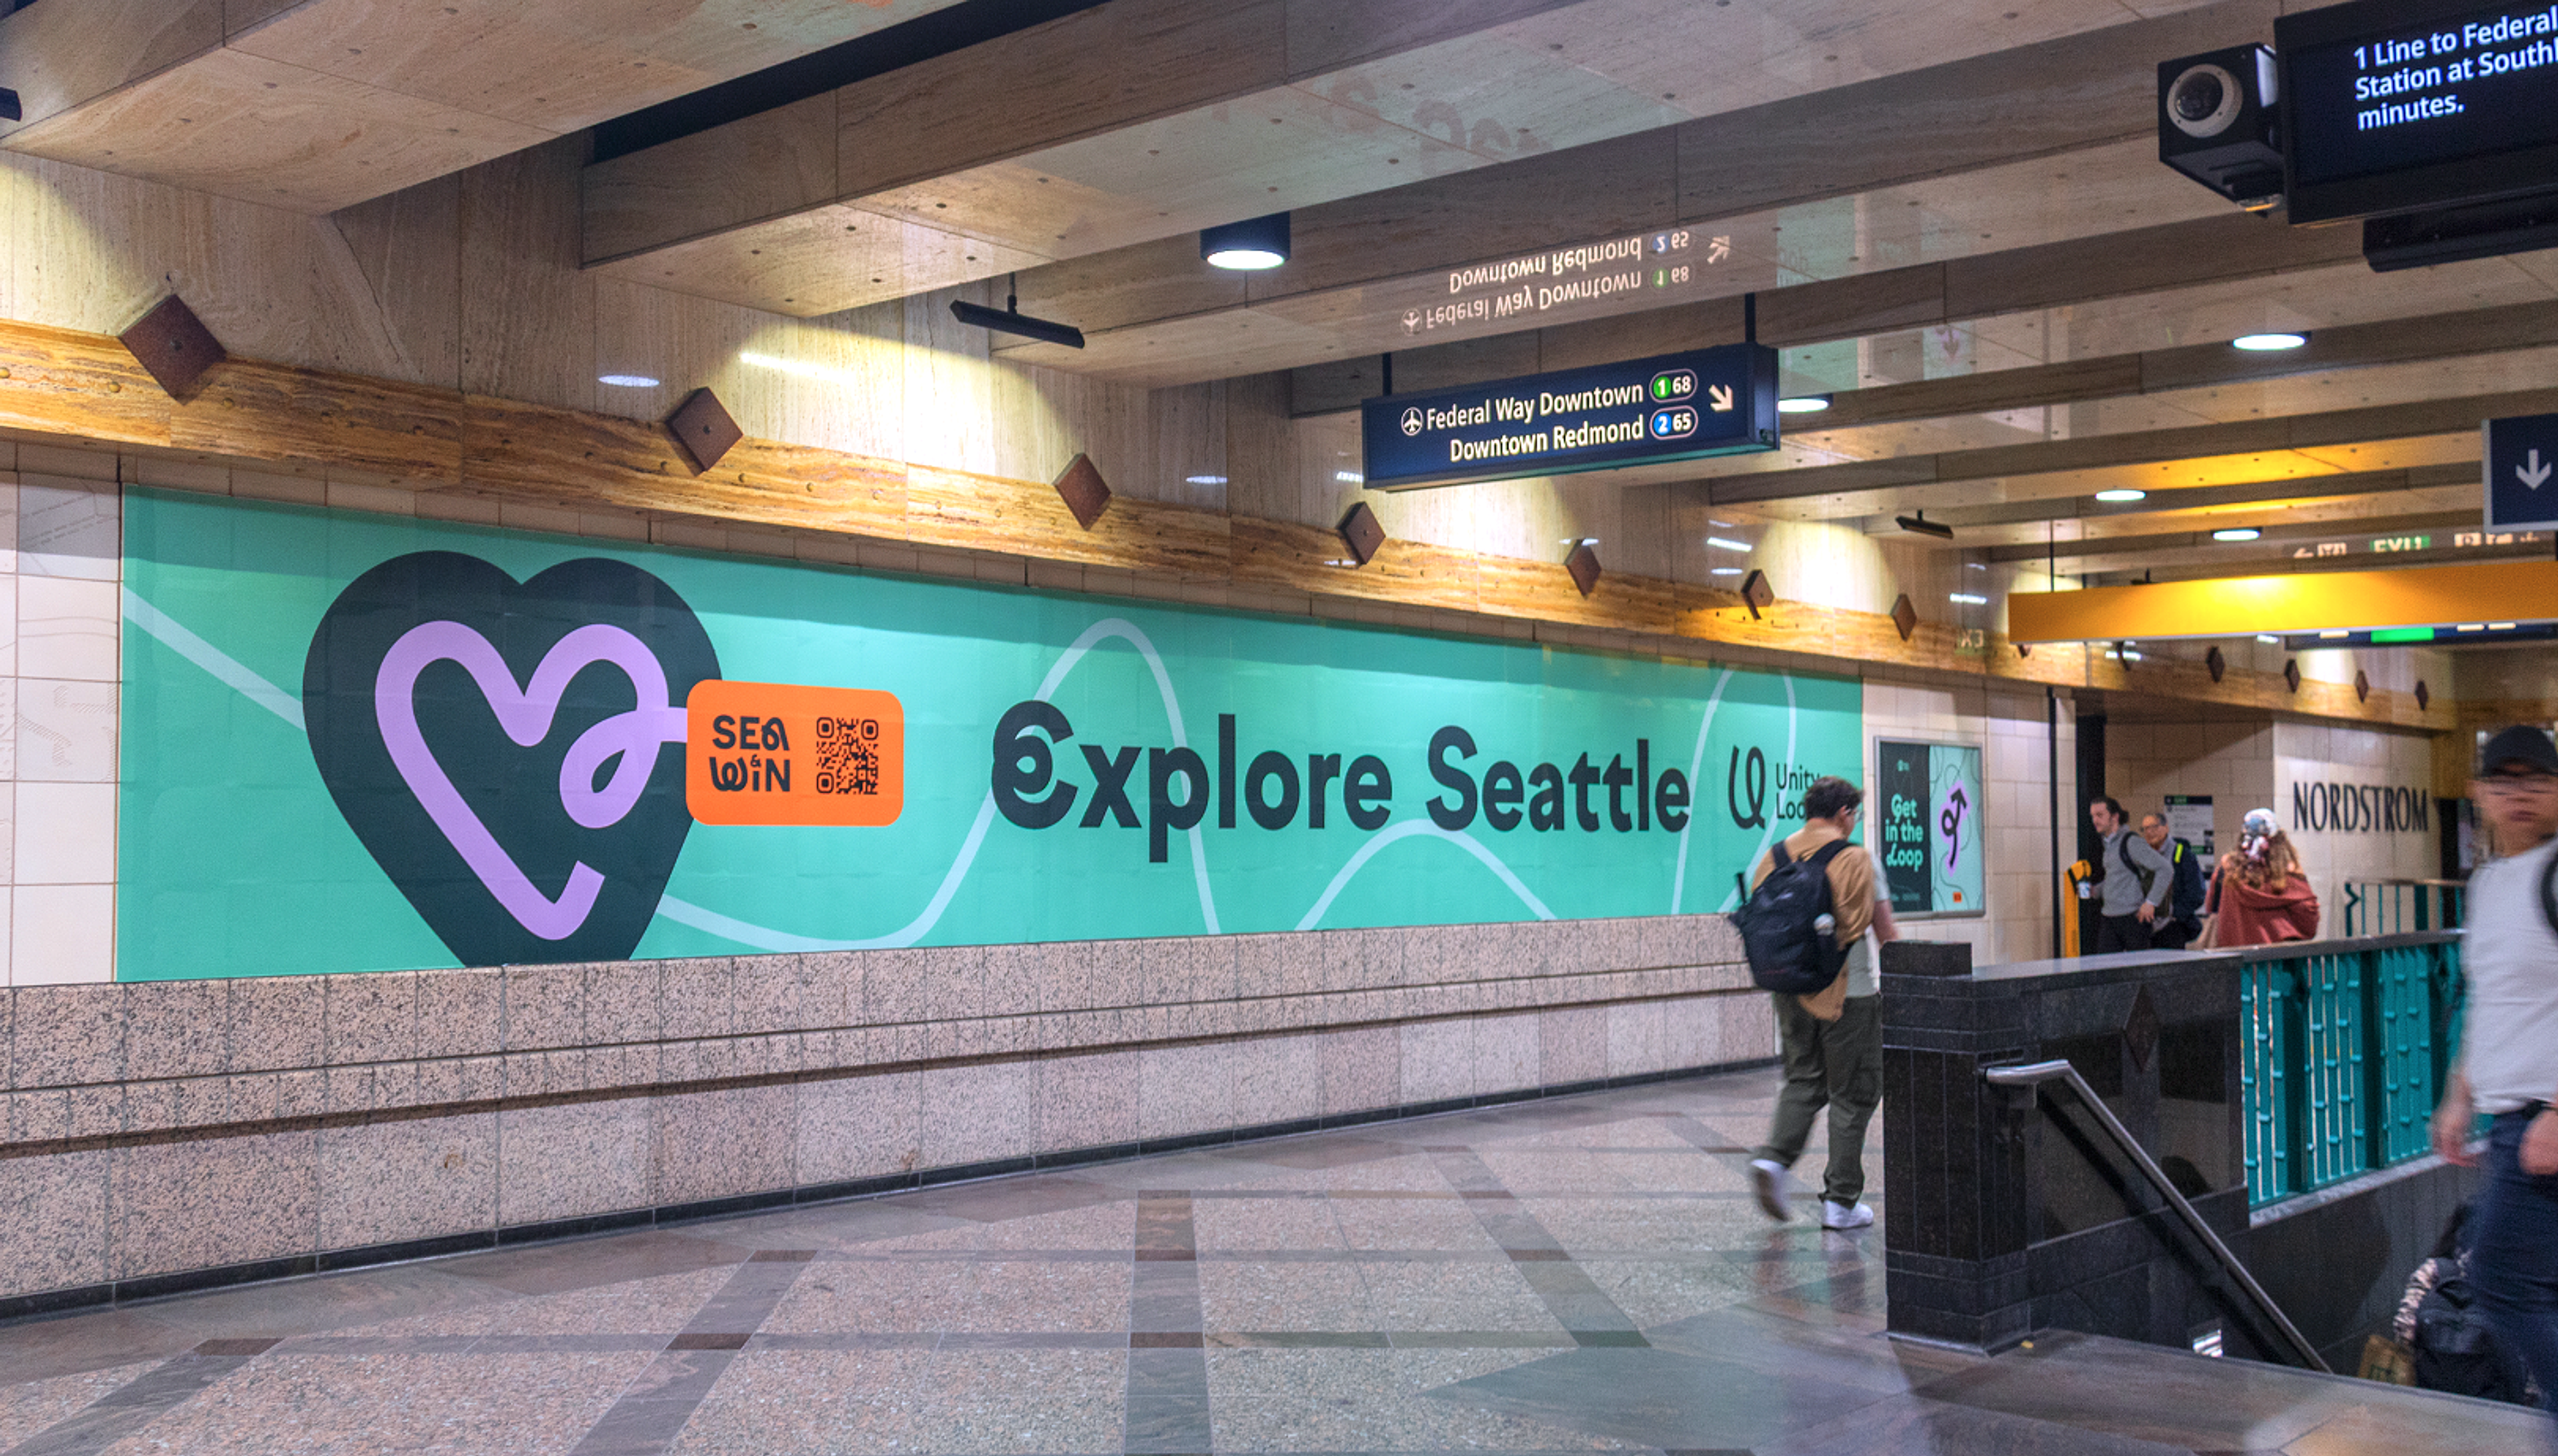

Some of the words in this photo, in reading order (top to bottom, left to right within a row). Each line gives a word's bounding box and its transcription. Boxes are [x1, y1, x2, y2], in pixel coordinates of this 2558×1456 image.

[2353, 46, 2367, 70] 1
[2373, 39, 2426, 67] Line
[2429, 32, 2459, 55] to
[2462, 5, 2558, 49] Federal
[2355, 67, 2442, 101] Station
[2447, 57, 2474, 83] at
[2357, 94, 2465, 131] minutes.
[1427, 399, 1491, 430] Federal
[1495, 397, 1535, 424] Way
[1539, 384, 1643, 416] Downtown
[1658, 380, 1665, 395] 1
[1673, 376, 1691, 394] 68
[1450, 432, 1548, 462] Downtown
[1553, 414, 1644, 450] Redmond
[1658, 416, 1668, 433] 2
[1673, 413, 1691, 431] 65
[712, 714, 789, 751] SEA
[991, 700, 1392, 863] Explore
[1426, 725, 1690, 832] Seattle
[1776, 792, 1807, 820] Loo
[1891, 793, 1917, 823] Get
[2294, 781, 2429, 833] NORDSTROM
[1885, 818, 1899, 842] in
[1900, 819, 1924, 842] the
[1886, 843, 1923, 872] Loop
